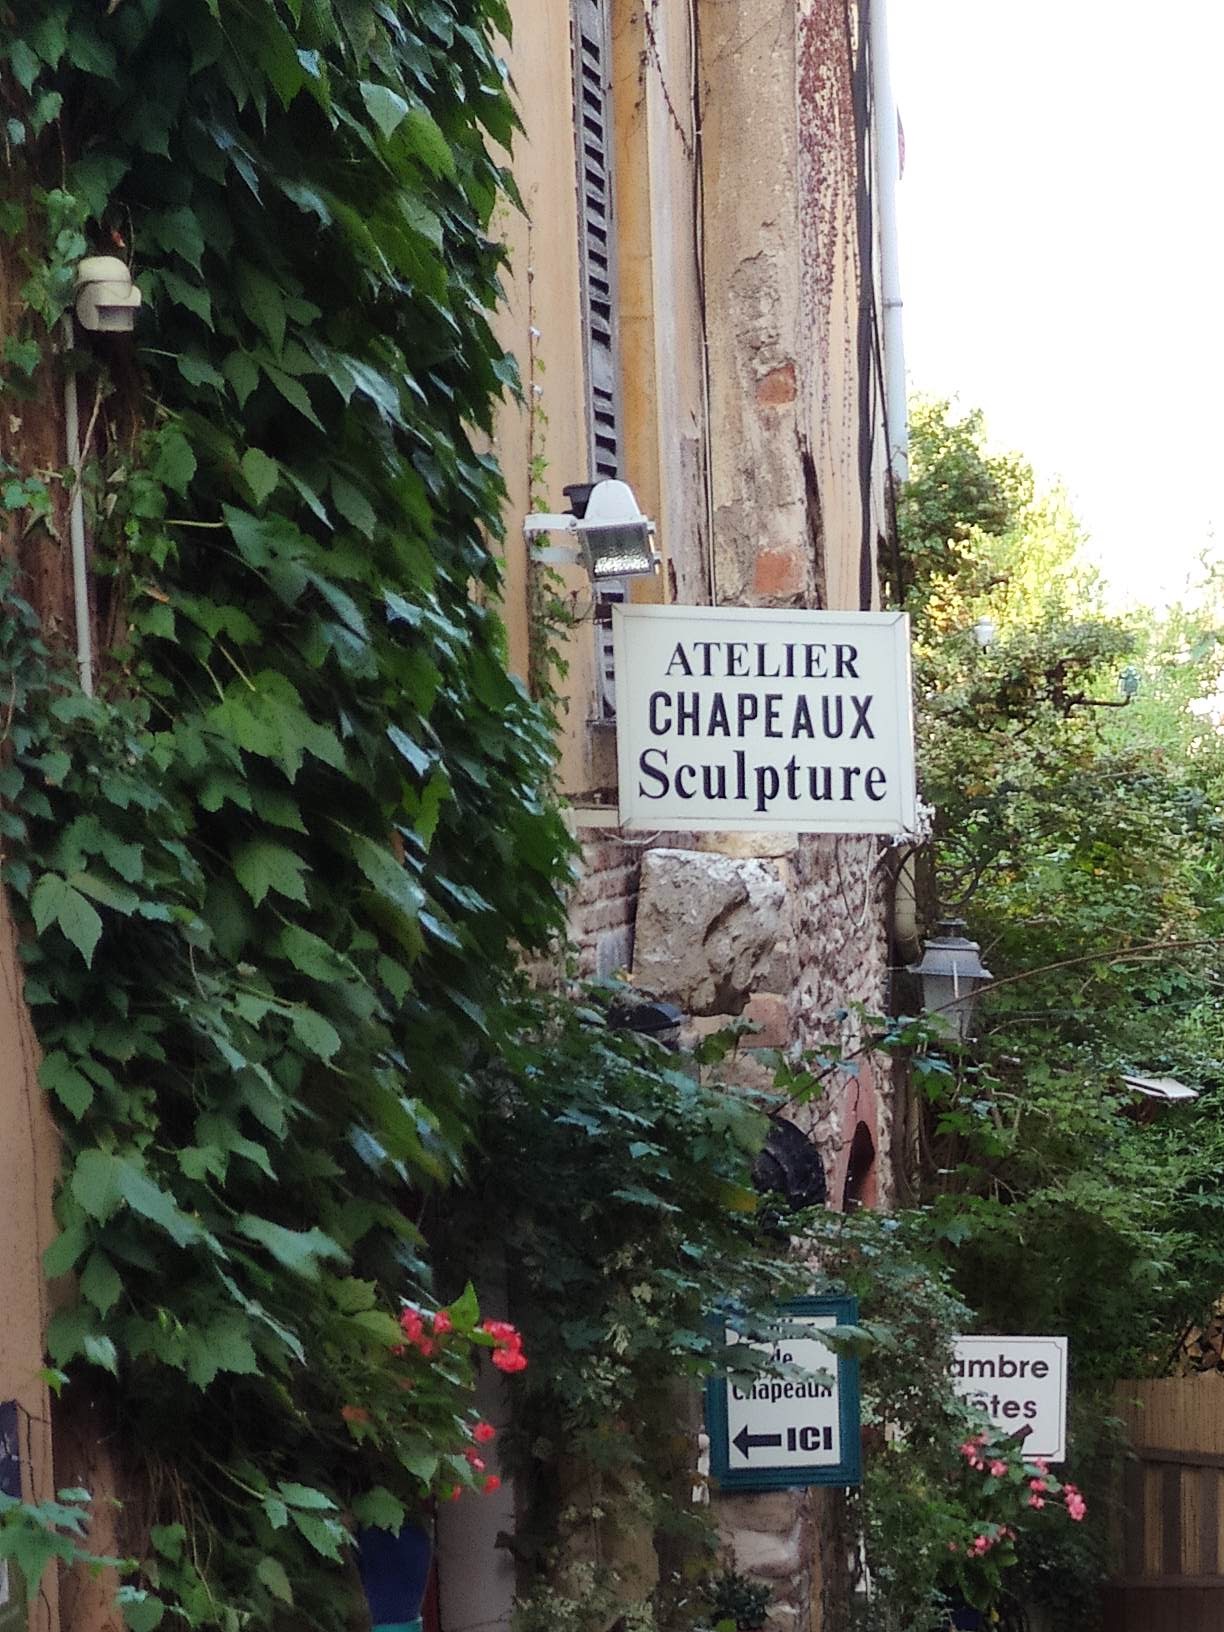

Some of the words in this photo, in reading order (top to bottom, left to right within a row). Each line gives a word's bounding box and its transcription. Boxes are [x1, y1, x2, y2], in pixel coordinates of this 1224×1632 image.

[664, 641, 860, 679] ATELIER
[649, 690, 875, 740] CHAPEAUX
[638, 747, 887, 812] Sculpture
[951, 1354, 1049, 1379] ambre
[787, 1426, 833, 1451] ICI
